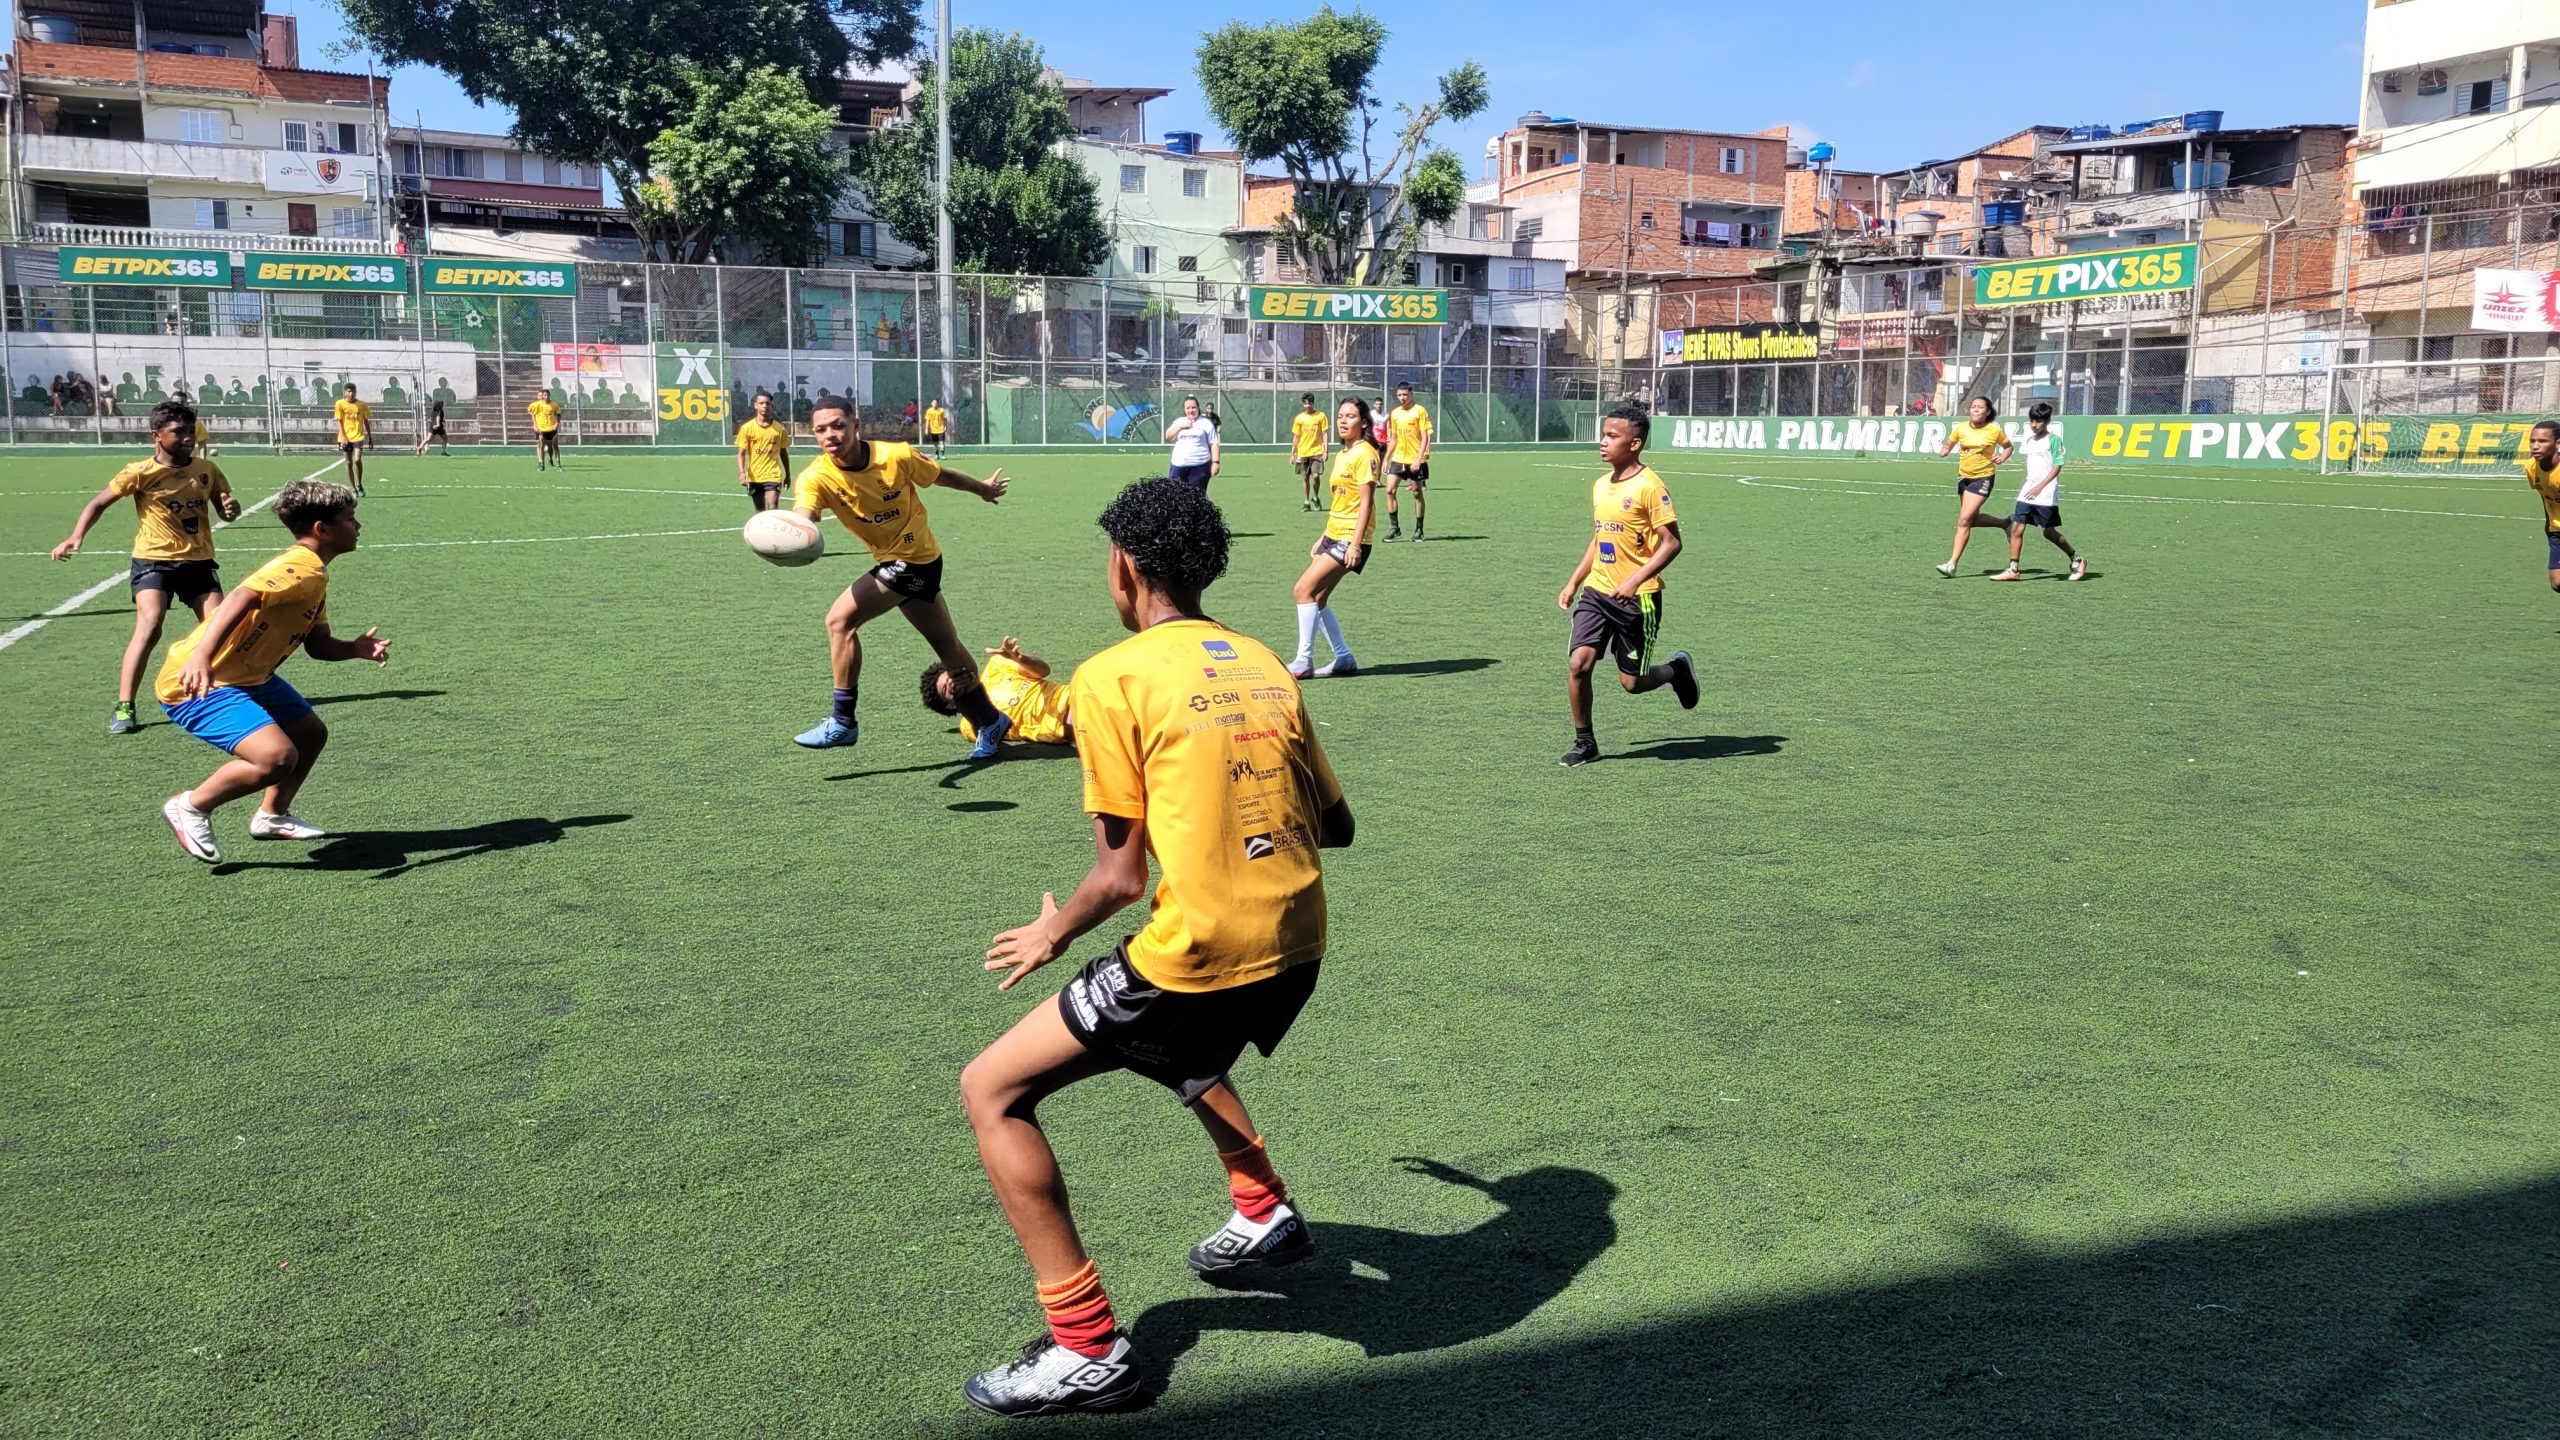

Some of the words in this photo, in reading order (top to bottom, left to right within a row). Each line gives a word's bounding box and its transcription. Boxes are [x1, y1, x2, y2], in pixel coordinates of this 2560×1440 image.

[73, 257, 219, 277] BETPIX365
[258, 263, 395, 283] BETPIX365
[1987, 252, 2182, 299] BETPIX365
[435, 268, 565, 287] BETPIX365
[1262, 292, 1437, 319] BETPIX365
[1708, 332, 1731, 360] PIPAS
[1732, 331, 1760, 359] Shows
[673, 348, 717, 386] X
[657, 388, 730, 421] 365
[1671, 420, 1766, 449] ARENA
[2091, 421, 2391, 463] BETPIX365
[874, 508, 900, 523] CSN
[1604, 522, 1624, 532] CSN
[1208, 648, 1235, 658] Itaú
[1212, 691, 1241, 705] CSN
[1251, 692, 1295, 701] OUTBACK
[1215, 712, 1246, 726] montana
[1234, 729, 1279, 744] FACCHINI
[1274, 831, 1308, 849] BRASIL
[1259, 1220, 1297, 1253] umbro
